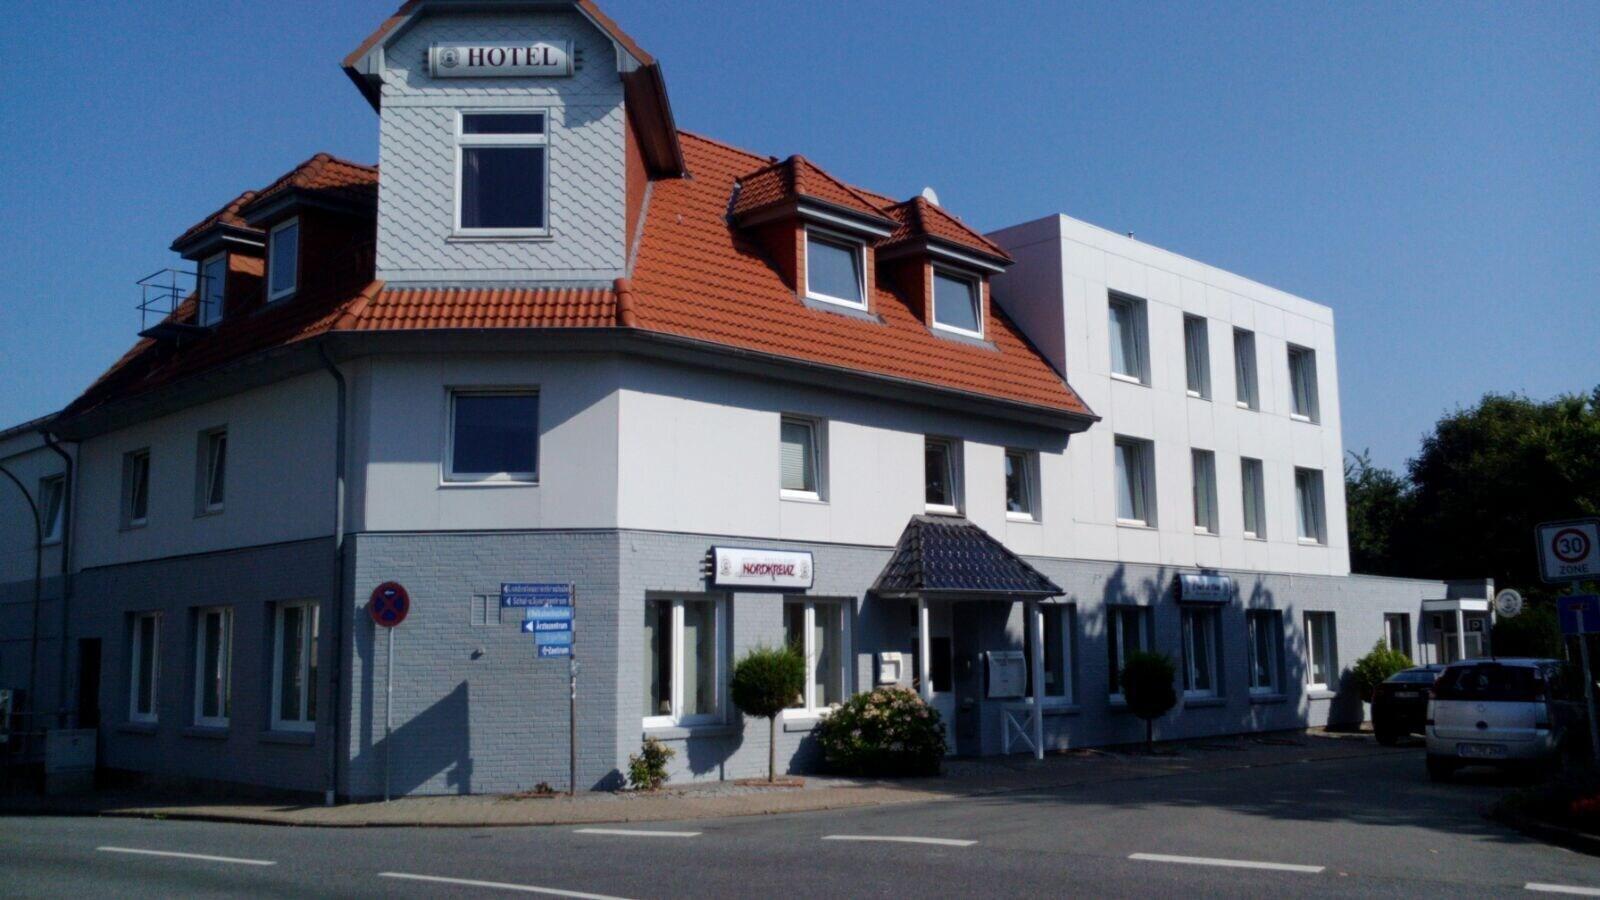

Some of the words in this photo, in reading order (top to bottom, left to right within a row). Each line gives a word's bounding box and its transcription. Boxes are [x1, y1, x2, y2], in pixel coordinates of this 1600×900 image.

[467, 47, 558, 67] HOTEL
[1559, 537, 1583, 554] 30
[743, 563, 795, 578] NORDKREUZ
[1559, 563, 1589, 575] ZONE
